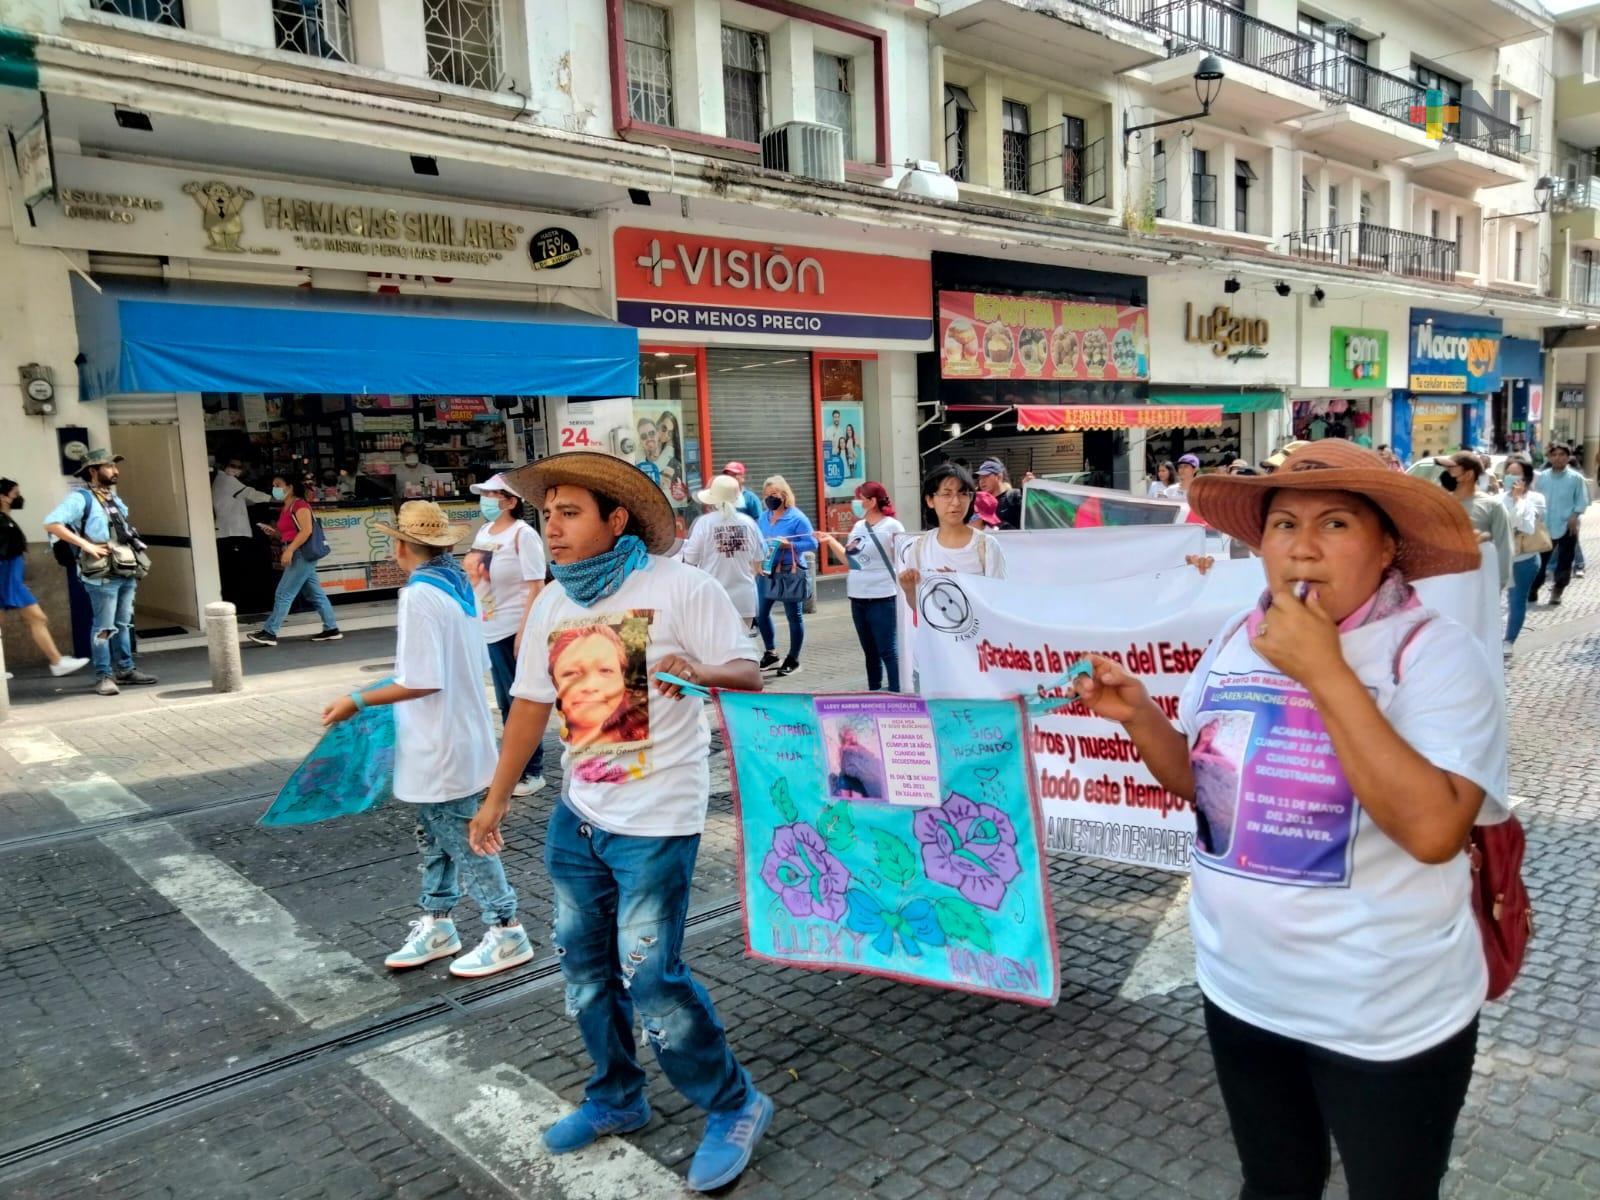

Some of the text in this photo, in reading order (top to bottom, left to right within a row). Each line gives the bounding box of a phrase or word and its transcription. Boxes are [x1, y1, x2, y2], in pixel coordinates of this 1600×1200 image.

[262, 196, 518, 251] FARMACIAS SIMILARES
[324, 238, 370, 256] MISMO
[371, 242, 408, 260] PERO
[410, 247, 438, 261] MAS
[537, 234, 571, 259] 75%
[650, 307, 821, 331] POR MENOS PRECIO
[1184, 301, 1269, 356] Lugano
[1416, 322, 1498, 372] Macropay
[450, 410, 473, 420] GRATIS
[561, 427, 590, 447] 24
[1034, 650, 1045, 673] a
[1044, 643, 1062, 673] la
[1127, 642, 1157, 674] del
[1158, 639, 1212, 674] Esta
[752, 707, 768, 720] TE
[1032, 724, 1141, 764] tros y nuestro
[1255, 736, 1298, 751] CUMPLIR
[1265, 752, 1326, 770] CUANDO LA
[1255, 764, 1336, 785] SECUESTRARON
[1041, 768, 1184, 819] todo este tiempo
[1245, 791, 1345, 814] EL DIA 11 DE MAYO
[1246, 820, 1260, 830] EN
[1261, 823, 1303, 838] XALAPA
[1265, 810, 1314, 825] DEL 2011
[1047, 816, 1193, 866] A NUESTROS DESAPAREC
[771, 924, 866, 959] LLEXY
[946, 944, 1040, 991] KAREN
